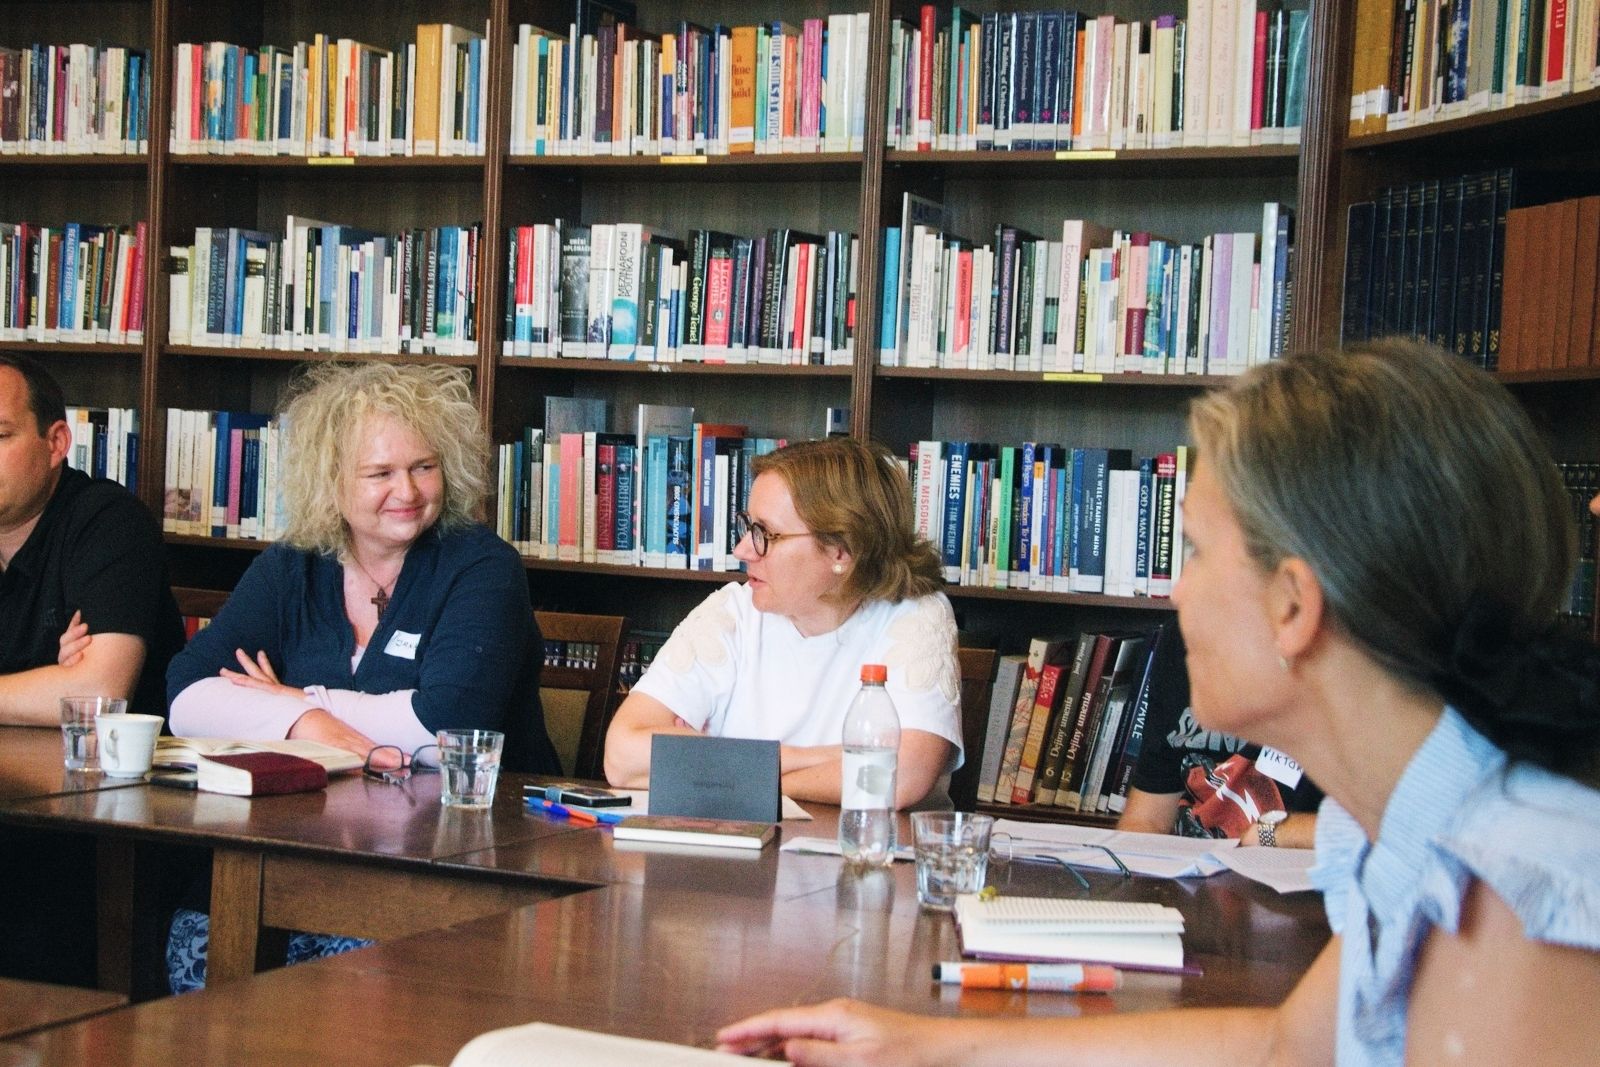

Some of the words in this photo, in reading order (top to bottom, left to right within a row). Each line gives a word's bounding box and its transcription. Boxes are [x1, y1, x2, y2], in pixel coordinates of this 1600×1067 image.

[1000, 46, 1009, 75] Building
[1020, 60, 1029, 100] Christendom
[999, 86, 1008, 129] Christendom
[67, 228, 76, 265] REALIZING
[404, 234, 413, 272] FIGHTING
[210, 245, 220, 293] AMERICAN
[217, 257, 226, 275] THE
[428, 250, 436, 281] CAPITOL
[617, 231, 628, 297] MEZINÁRODNÍ
[624, 256, 634, 297] POLITIKA
[1002, 252, 1011, 288] ECONOMIC
[1061, 244, 1079, 303] Economics
[64, 266, 74, 301] FREEDOM
[216, 277, 225, 310] ROOTS
[404, 284, 412, 301] LIFE
[690, 276, 703, 314] George
[711, 271, 720, 305] ASHES
[720, 262, 730, 306] LEGACY
[765, 270, 773, 301] HUMAN
[1275, 280, 1283, 310] podnik
[208, 296, 218, 328] ORDER
[425, 283, 435, 332] PUNISHMENT
[911, 284, 921, 321] PETROSTATE
[1000, 289, 1009, 331] DEPENDENCY
[689, 314, 701, 343] Tenet
[762, 303, 771, 338] DESTINY
[769, 301, 779, 339] POVERTY
[999, 333, 1007, 349] TRAP
[585, 457, 593, 467] TO
[921, 453, 932, 481] FATAL
[1023, 447, 1032, 463] Carl
[948, 454, 963, 500] ENEMIES
[1022, 464, 1032, 487] Rogers
[617, 476, 631, 516] DRUHÝ
[673, 486, 681, 501] 2008
[1094, 479, 1104, 533] WELL-TRAINED
[1139, 484, 1150, 506] GOD
[1161, 484, 1173, 533] HARVARD
[672, 500, 681, 545] SLOVENSKO
[948, 507, 957, 521] TIM
[1021, 496, 1031, 526] Freedom
[1138, 516, 1148, 538] MAN
[616, 518, 629, 549] DYCH
[946, 523, 957, 555] WEINER
[1020, 538, 1029, 559] Learn
[1021, 527, 1030, 537] To
[1092, 534, 1101, 557] MIND
[1138, 539, 1147, 549] AT
[1137, 552, 1146, 573] YALE
[1159, 536, 1170, 569] RULES
[1049, 727, 1067, 759] Dejiny
[1061, 696, 1074, 728] umenia
[1067, 728, 1084, 761] Dejiny
[1078, 692, 1092, 728] umenia
[1045, 767, 1055, 777] 6
